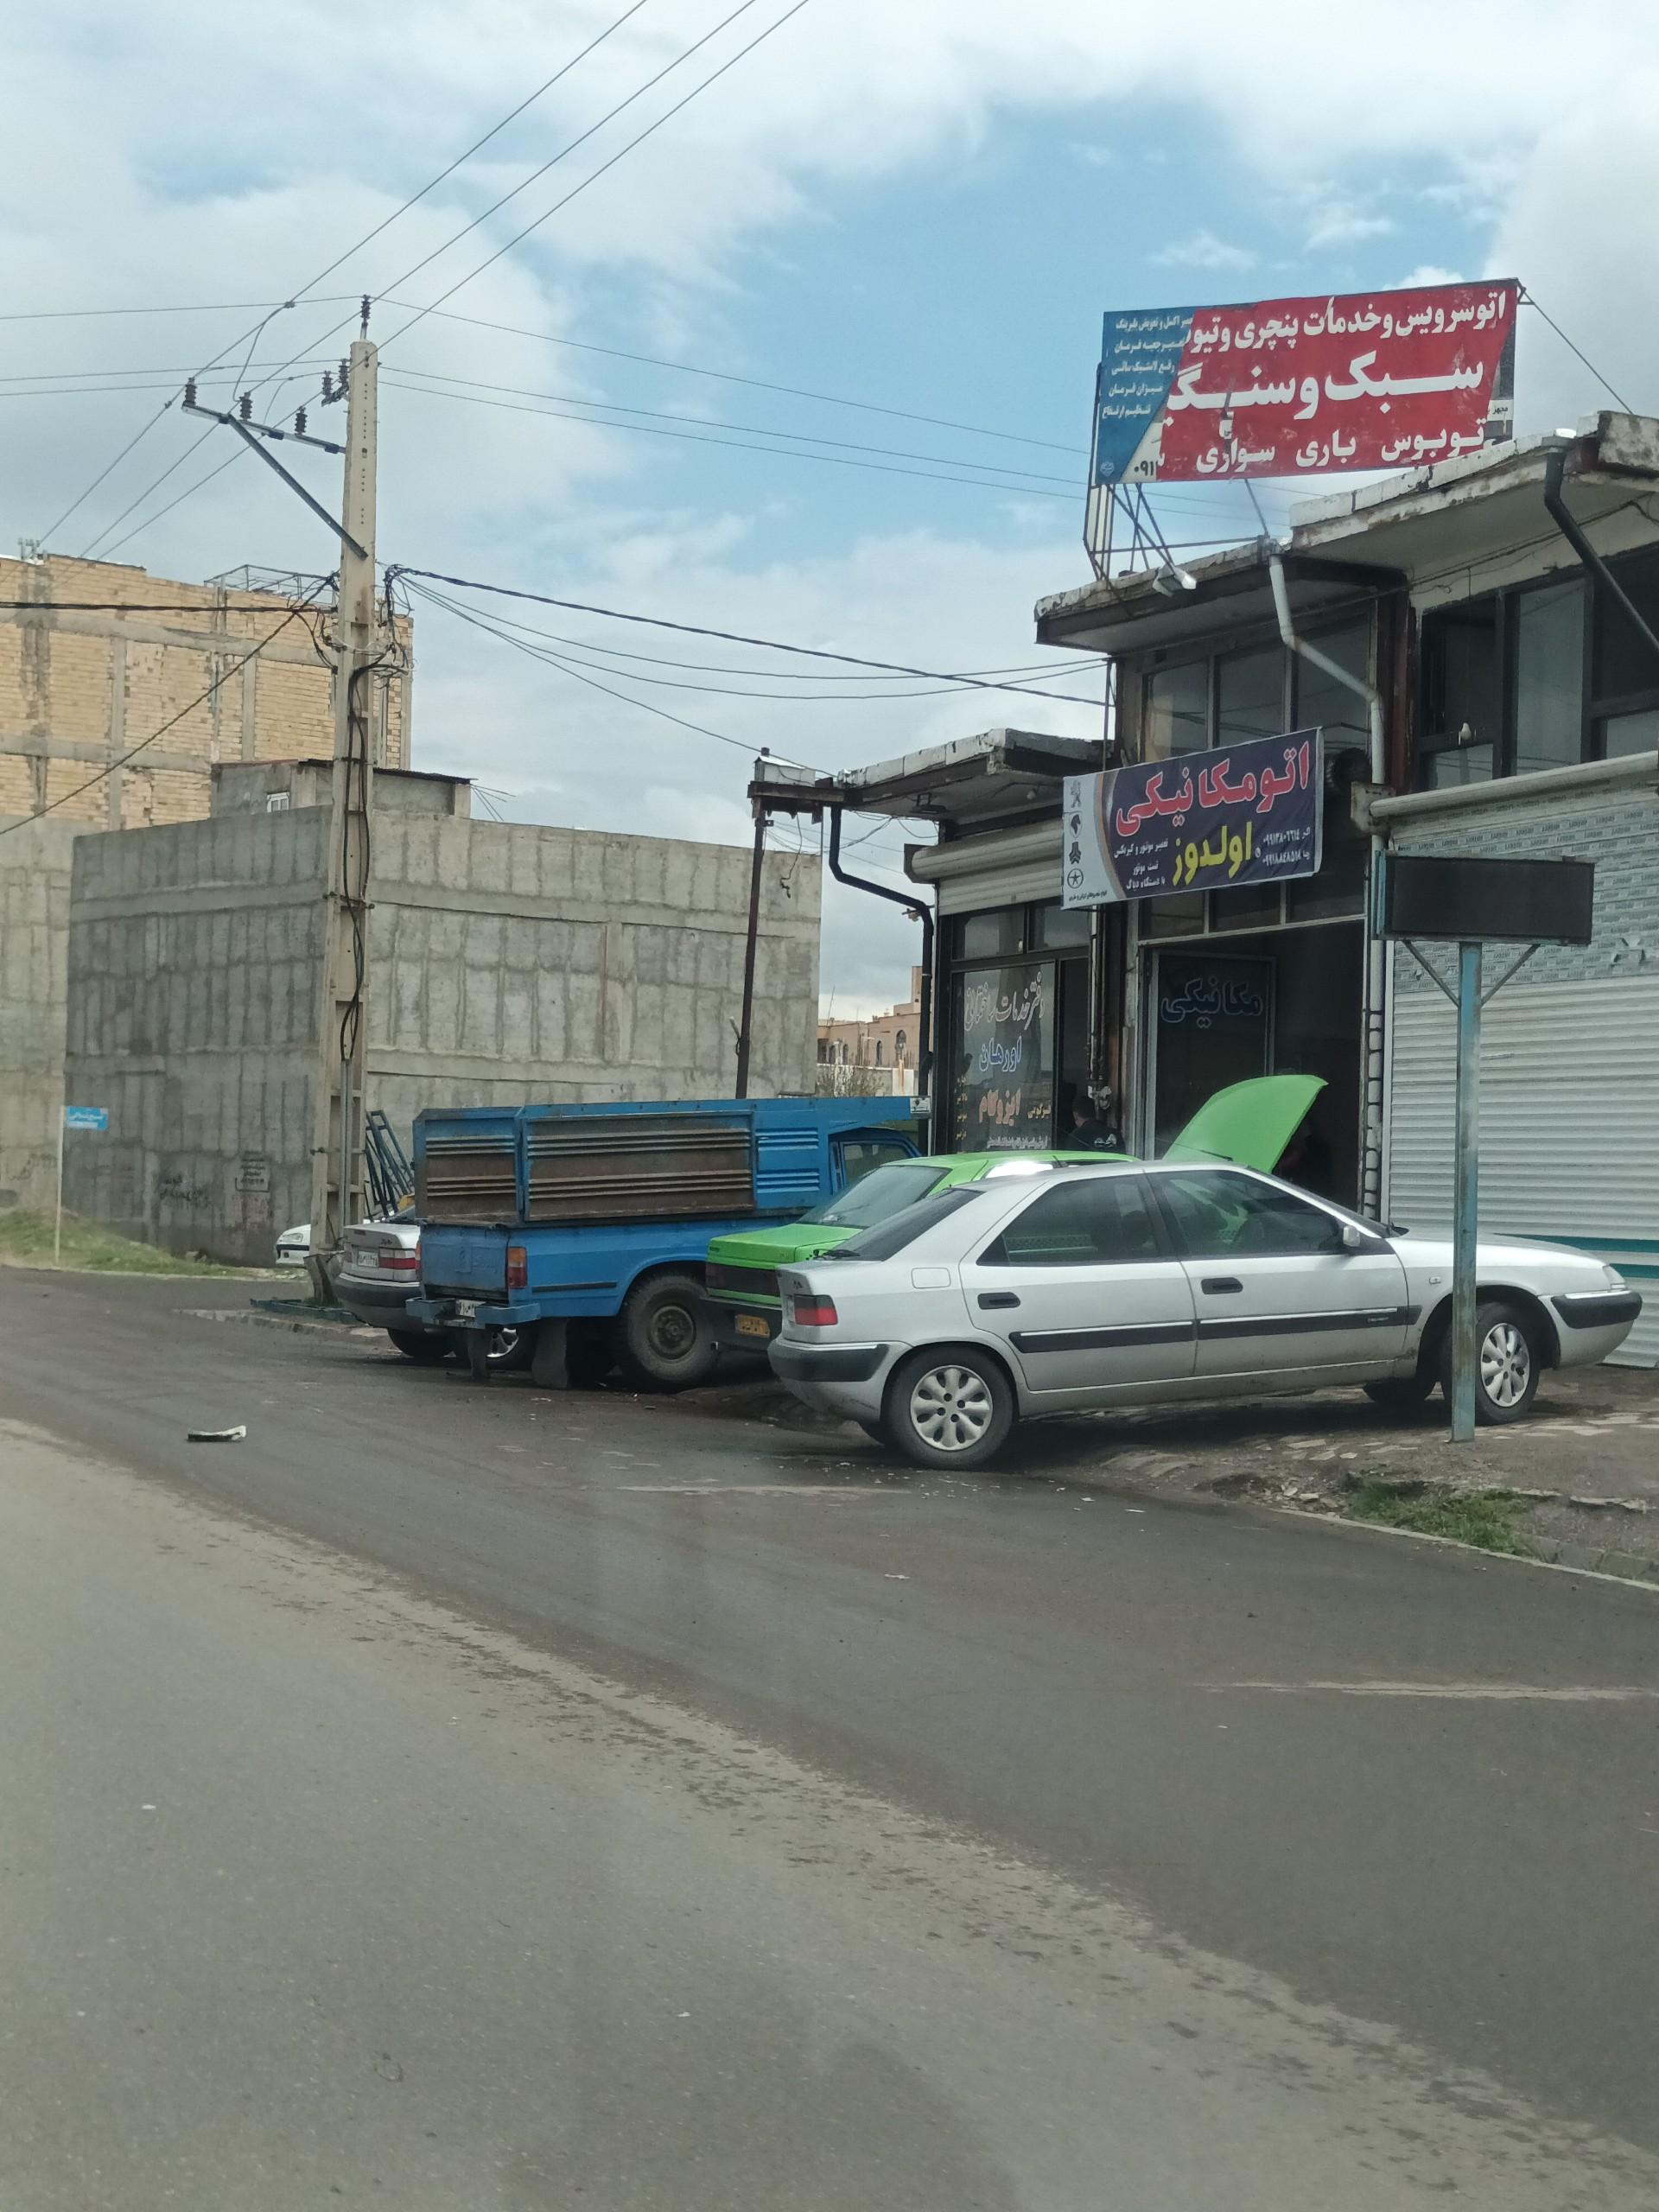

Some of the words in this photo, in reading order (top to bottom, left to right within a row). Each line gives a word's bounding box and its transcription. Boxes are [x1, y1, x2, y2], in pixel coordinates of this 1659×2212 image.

[1234, 313, 1299, 352] پنچری
[1325, 350, 1484, 414] سبک
[1196, 437, 1276, 474] سواری
[1295, 430, 1357, 468] باری
[1381, 417, 1487, 462] توبوس
[1172, 821, 1254, 887] اولدوز
[1160, 975, 1263, 1029] مکانیکی
[978, 1035, 1022, 1072] اورهان
[978, 1087, 1021, 1127] ایزوگام
